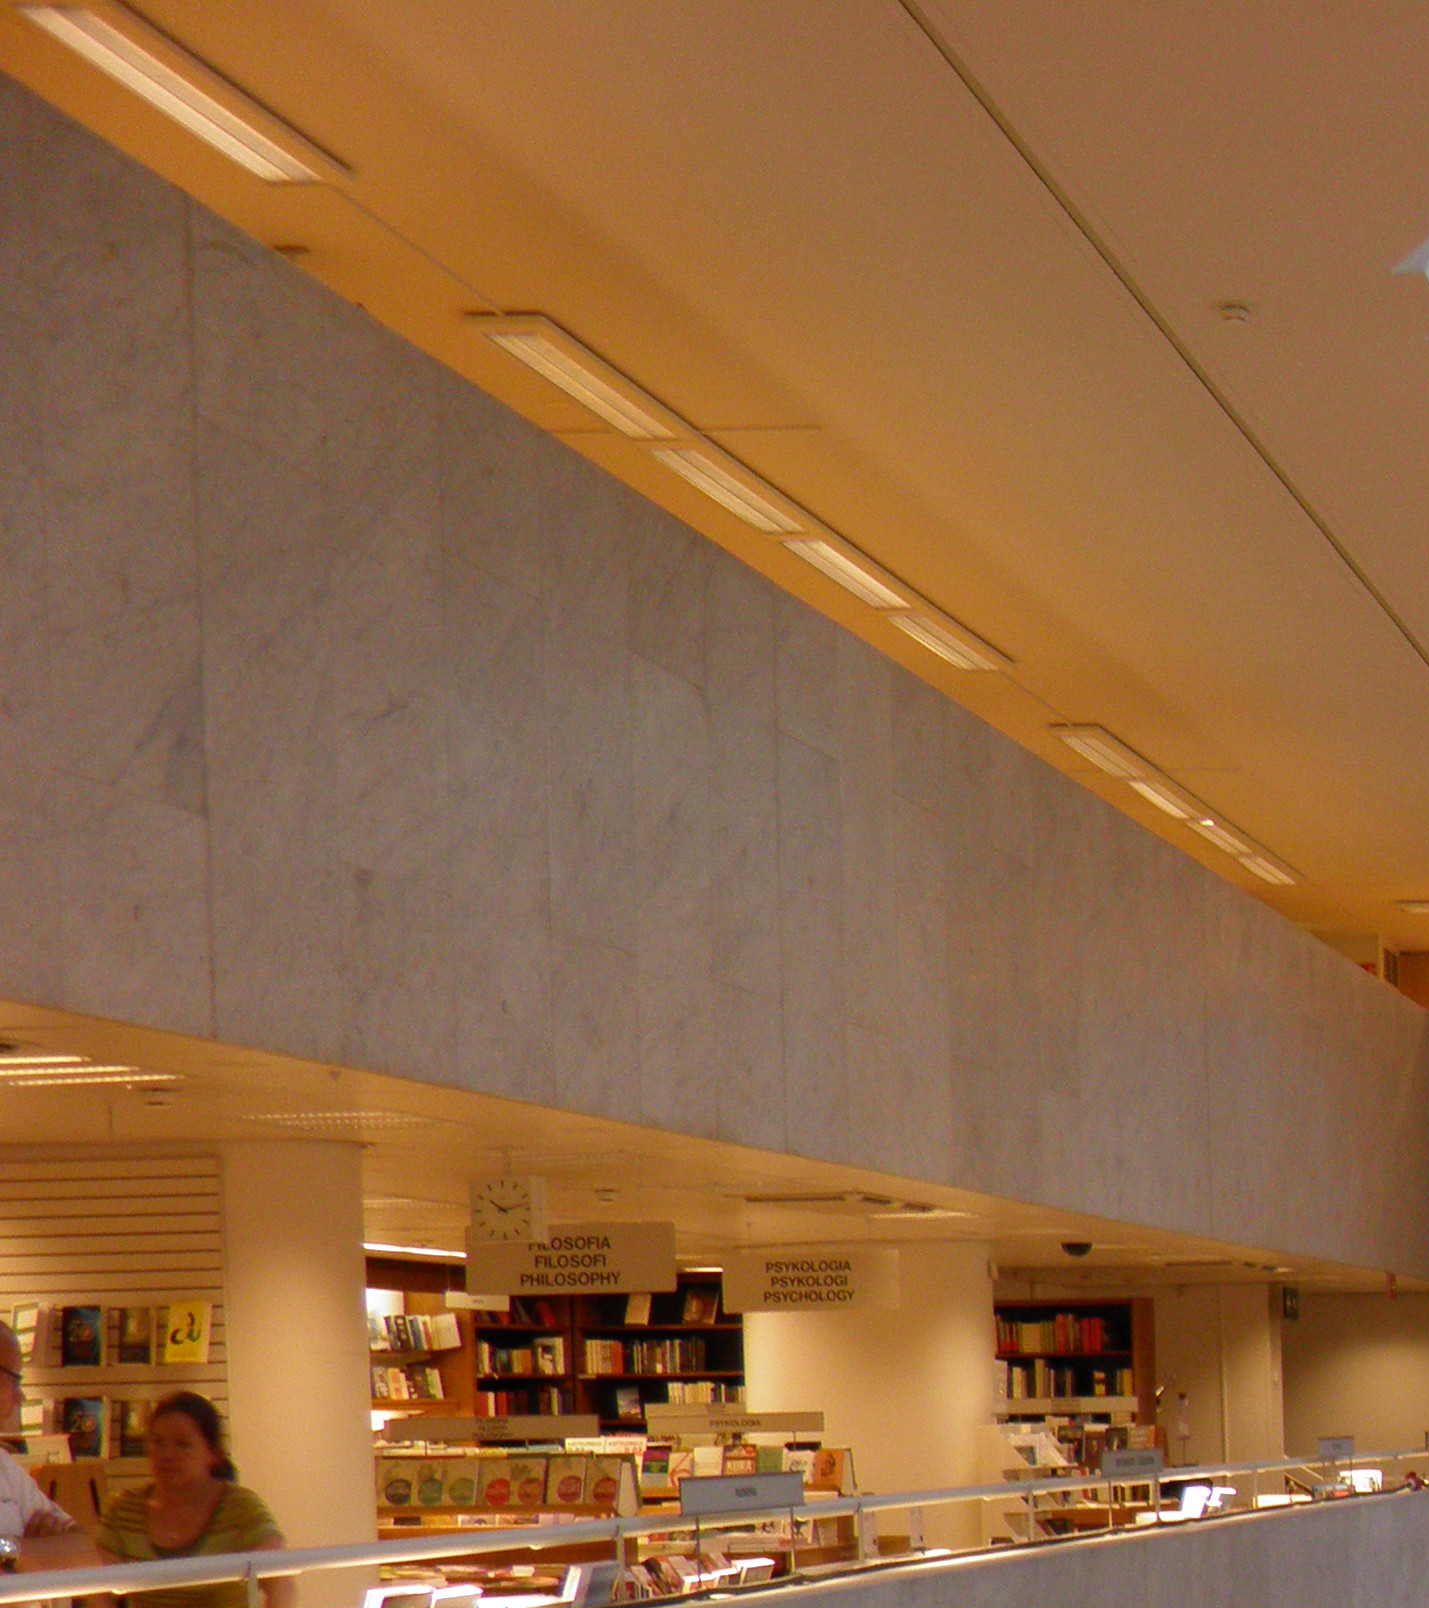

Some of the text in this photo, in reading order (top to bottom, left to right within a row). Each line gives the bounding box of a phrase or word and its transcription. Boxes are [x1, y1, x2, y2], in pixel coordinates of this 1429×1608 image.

[534, 1253, 607, 1268] FILOSOFI
[764, 1260, 852, 1274] PSYKOLOGIA
[519, 1270, 620, 1287] PHILOSOPHY
[770, 1275, 848, 1288] PSYKOLOGI
[763, 1289, 855, 1303] PSYCHOLOGY
